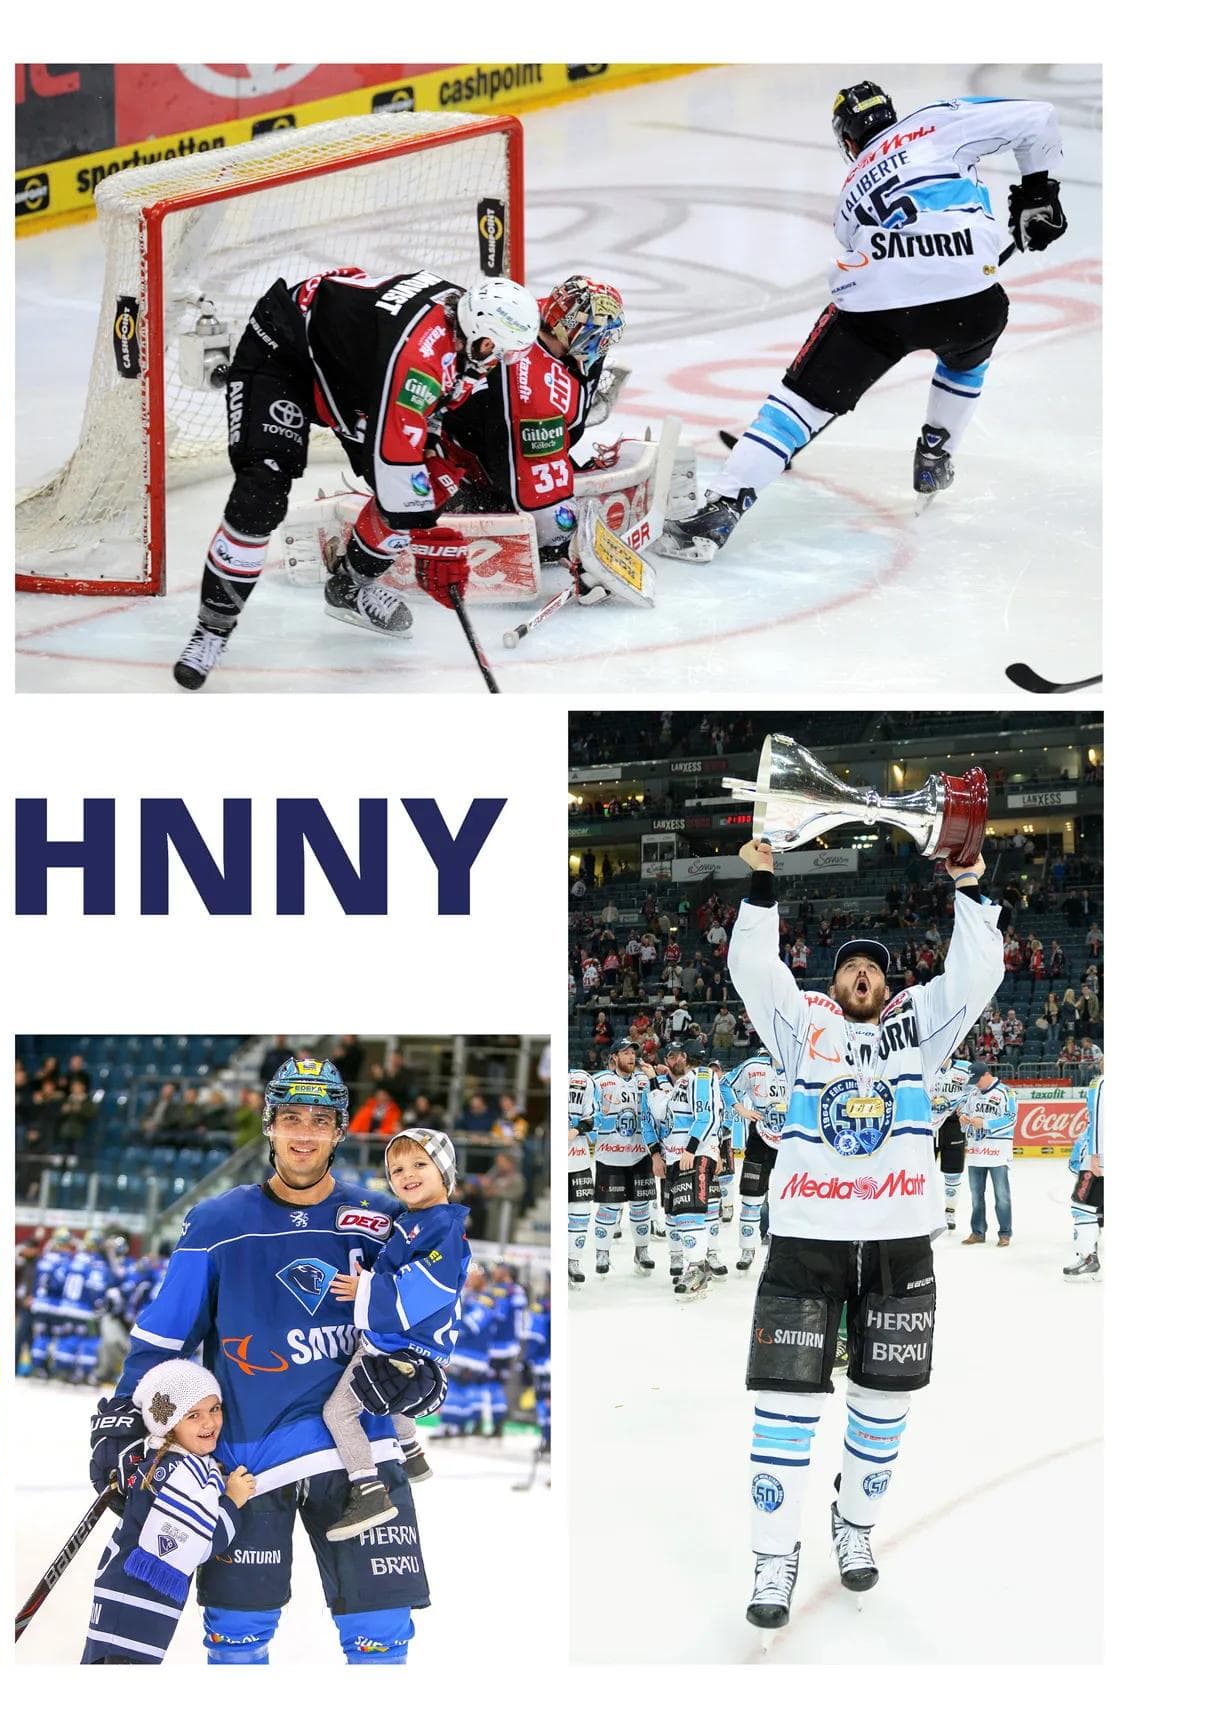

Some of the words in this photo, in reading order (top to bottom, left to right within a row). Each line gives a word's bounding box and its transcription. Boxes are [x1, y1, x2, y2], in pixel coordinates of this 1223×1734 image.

[439, 62, 543, 110] cashpoint
[871, 227, 975, 261] SATURN
[229, 380, 244, 446] AURIS
[262, 423, 304, 446] TOYOTA
[403, 425, 424, 448] 7
[521, 426, 564, 443] Gilden
[530, 459, 570, 494] 33
[294, 1085, 323, 1094] EDEKA
[1031, 1087, 1066, 1099] taxofit
[780, 1171, 855, 1201] Media
[874, 1168, 927, 1201] Markt
[339, 1213, 391, 1233] DEL
[866, 1309, 934, 1333] HERRN
[773, 1328, 824, 1350] SATURN
[871, 1342, 928, 1365] BRÄU
[234, 1549, 281, 1565] SATURN
[371, 1555, 420, 1576] BRÄU
